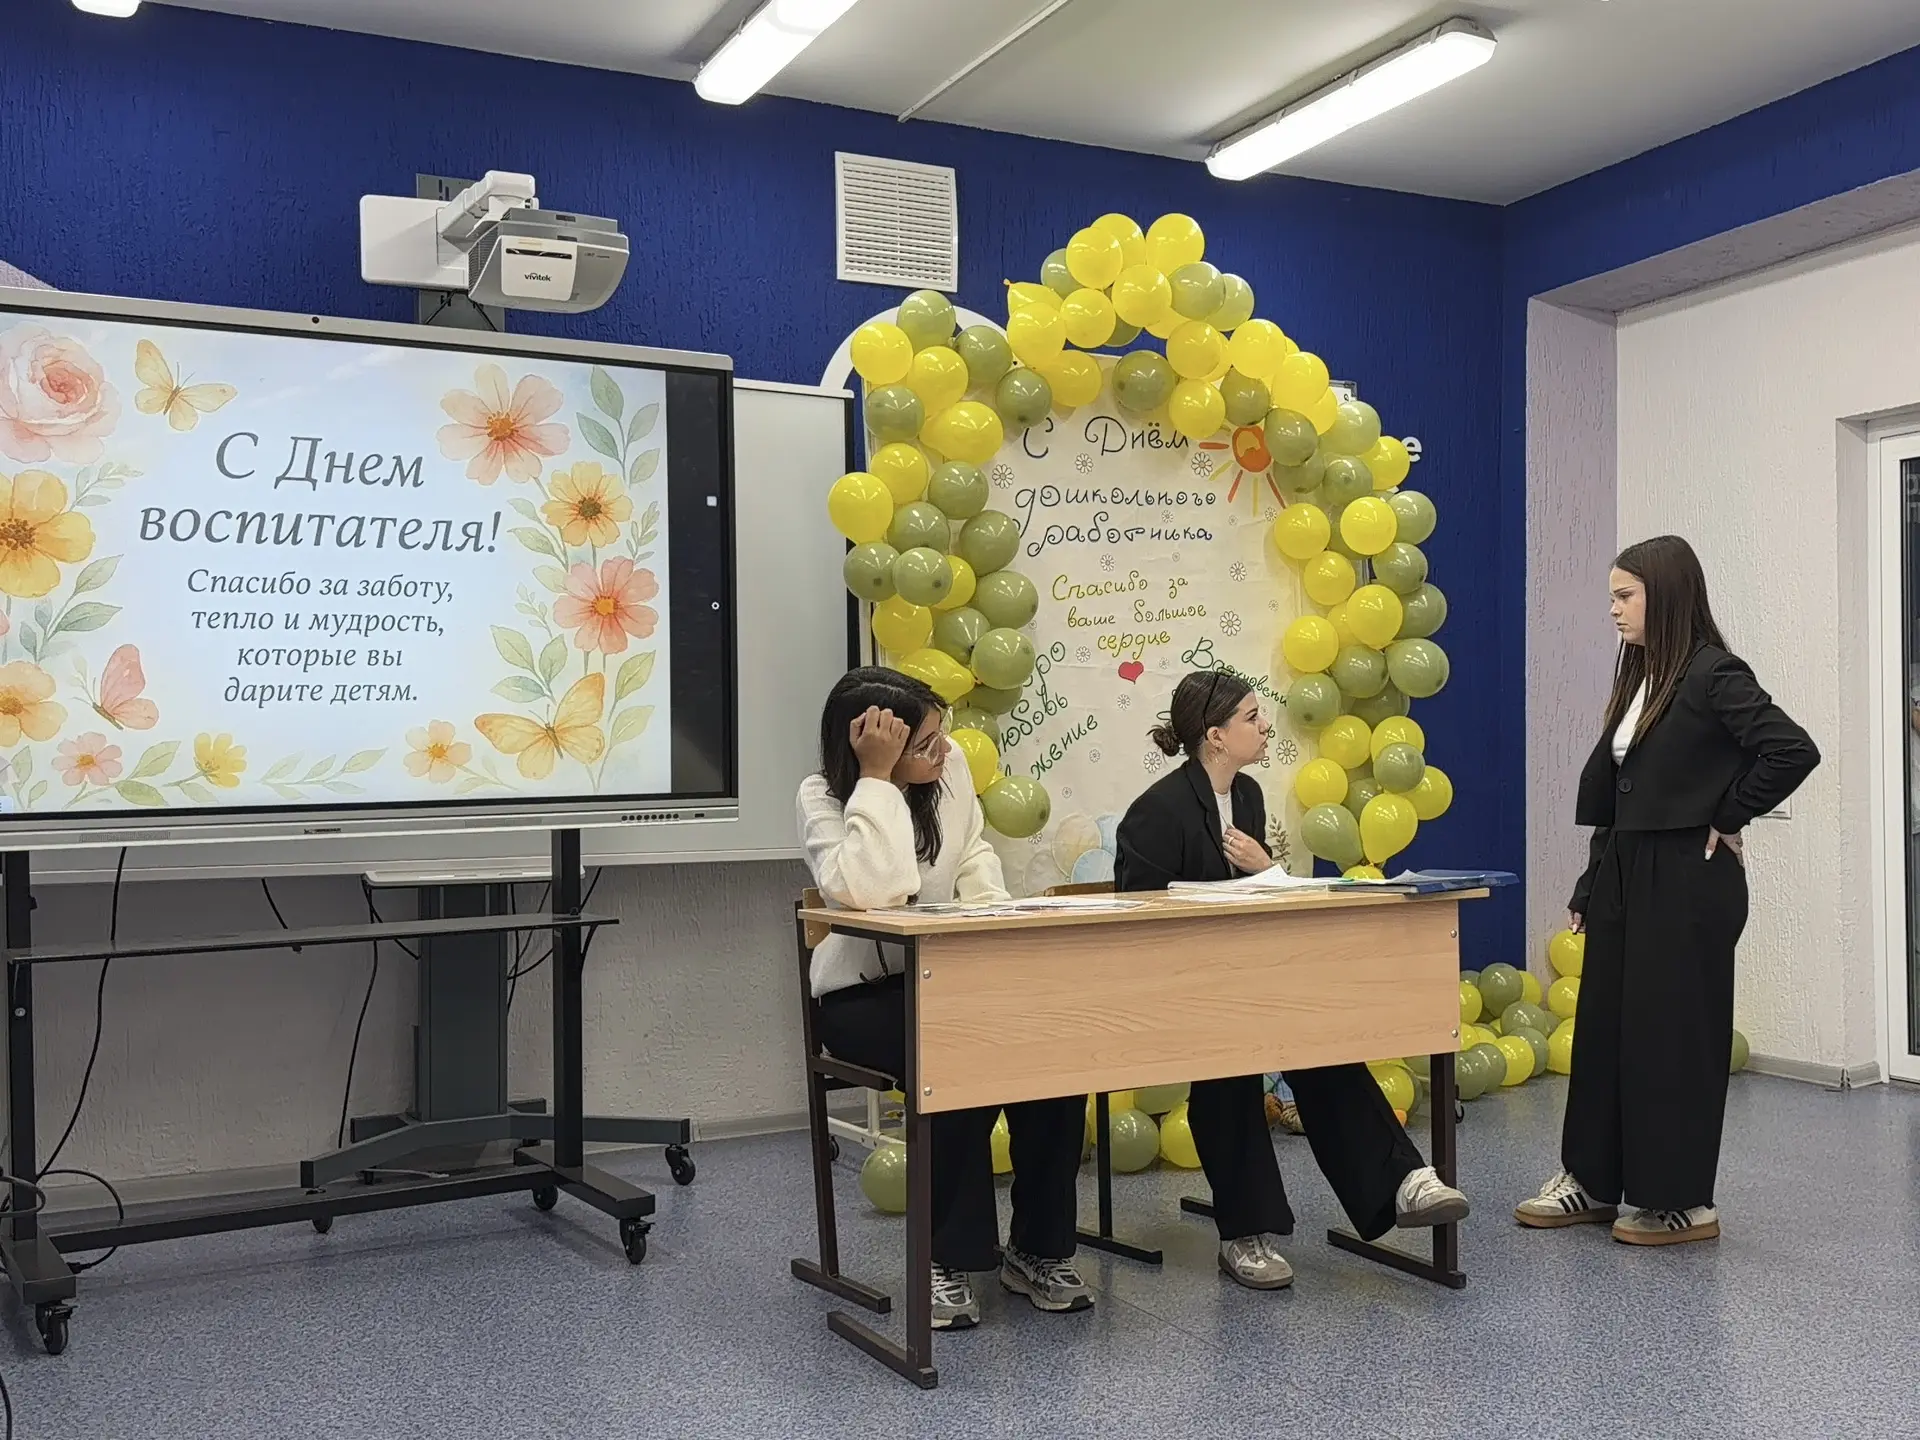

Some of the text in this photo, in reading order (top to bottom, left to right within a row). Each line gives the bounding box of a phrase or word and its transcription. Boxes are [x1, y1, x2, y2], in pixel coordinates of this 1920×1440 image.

[524, 272, 551, 282] vivitek
[215, 432, 425, 491] С Днем
[1013, 484, 1217, 539] дошкольного
[139, 507, 502, 553] воспитателя!
[1026, 511, 1214, 557] работника
[187, 568, 454, 603] Спасибо за заботу,
[1051, 570, 1189, 602] Спасибо за
[191, 610, 445, 637] тепло и мудрость,
[1067, 599, 1207, 629] ваше большое
[237, 647, 403, 673] которые вы
[1097, 629, 1172, 660] сердце
[223, 677, 418, 708] дарите детям.
